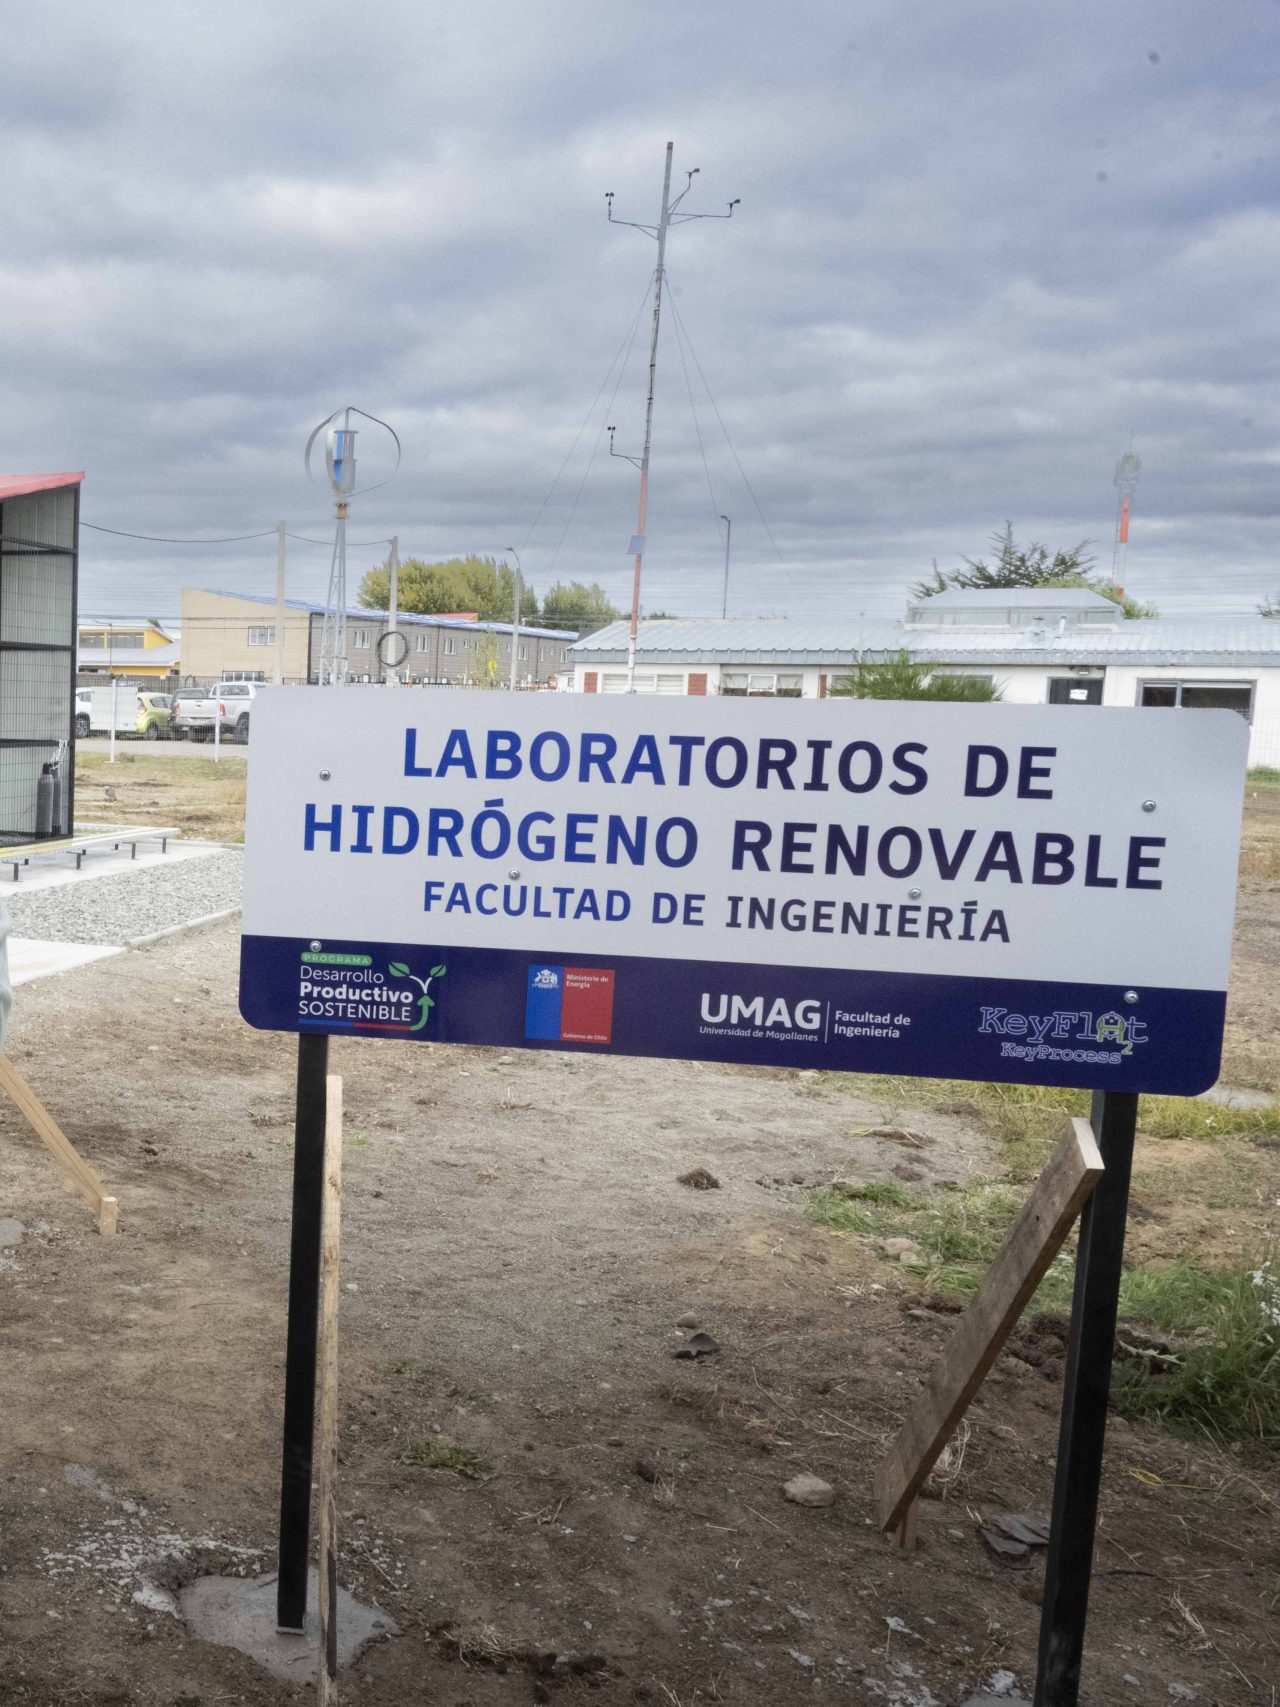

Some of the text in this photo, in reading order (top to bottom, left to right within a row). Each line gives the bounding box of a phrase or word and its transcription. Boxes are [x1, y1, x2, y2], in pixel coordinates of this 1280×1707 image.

[403, 727, 1058, 800] LABORATORIOS DE
[302, 797, 1167, 891] HIDRÓGENO RENOVABLE
[423, 880, 1011, 943] FACULTAD DE INGENIERÍA
[304, 954, 369, 964] PROGRAMA
[300, 965, 384, 984] Desarrollo
[566, 974, 599, 982] Ministerio
[300, 981, 414, 1004] Productivo
[298, 1000, 412, 1022] SOSTENIBLE
[700, 993, 821, 1030] UMAG
[835, 1010, 912, 1026] Facultad de
[563, 1032, 586, 1040] Gobierno
[594, 1033, 608, 1041] Chile
[699, 1026, 819, 1042] Universidad de Magallanes
[834, 1023, 901, 1039] Ingeniería
[1000, 1042, 1122, 1065] KeyProcess
